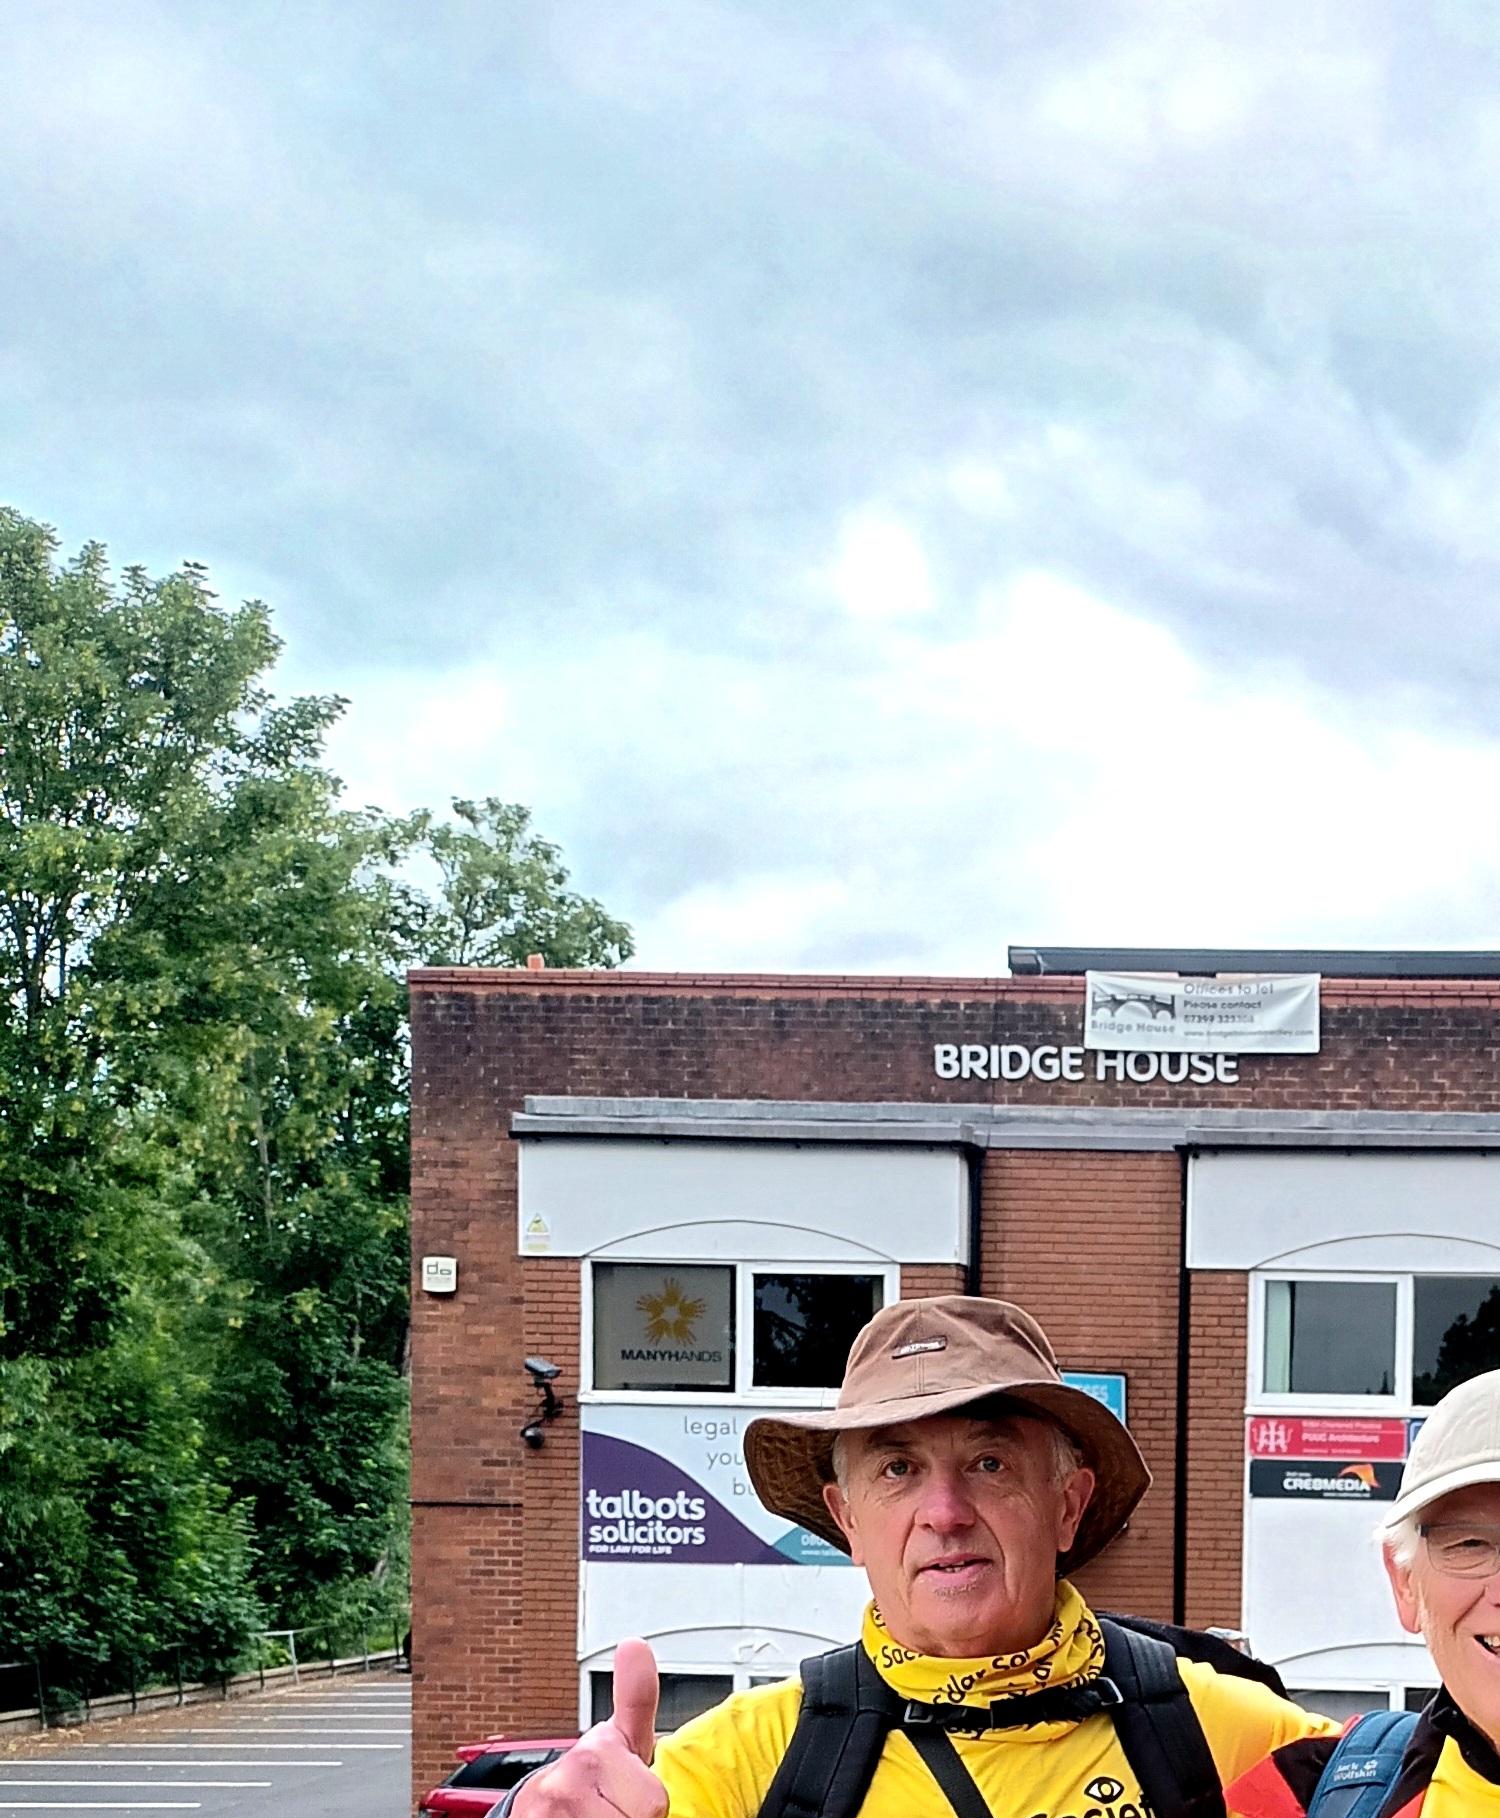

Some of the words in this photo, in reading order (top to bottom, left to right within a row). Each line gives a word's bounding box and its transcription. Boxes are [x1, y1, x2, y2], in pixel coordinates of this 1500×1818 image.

[1091, 1019, 1133, 1034] Bridge
[1136, 1022, 1176, 1033] House
[933, 1044, 1085, 1081] BRIDGE
[1096, 1052, 1240, 1084] HOUSE
[620, 1349, 723, 1362] MANYHANDS
[684, 1416, 738, 1441] legal
[586, 1489, 706, 1521] talbots
[589, 1520, 706, 1545] solicitors
[589, 1545, 609, 1553] FOR
[610, 1545, 632, 1554] LAW
[632, 1546, 652, 1554] FOR
[652, 1546, 673, 1555] LIFE
